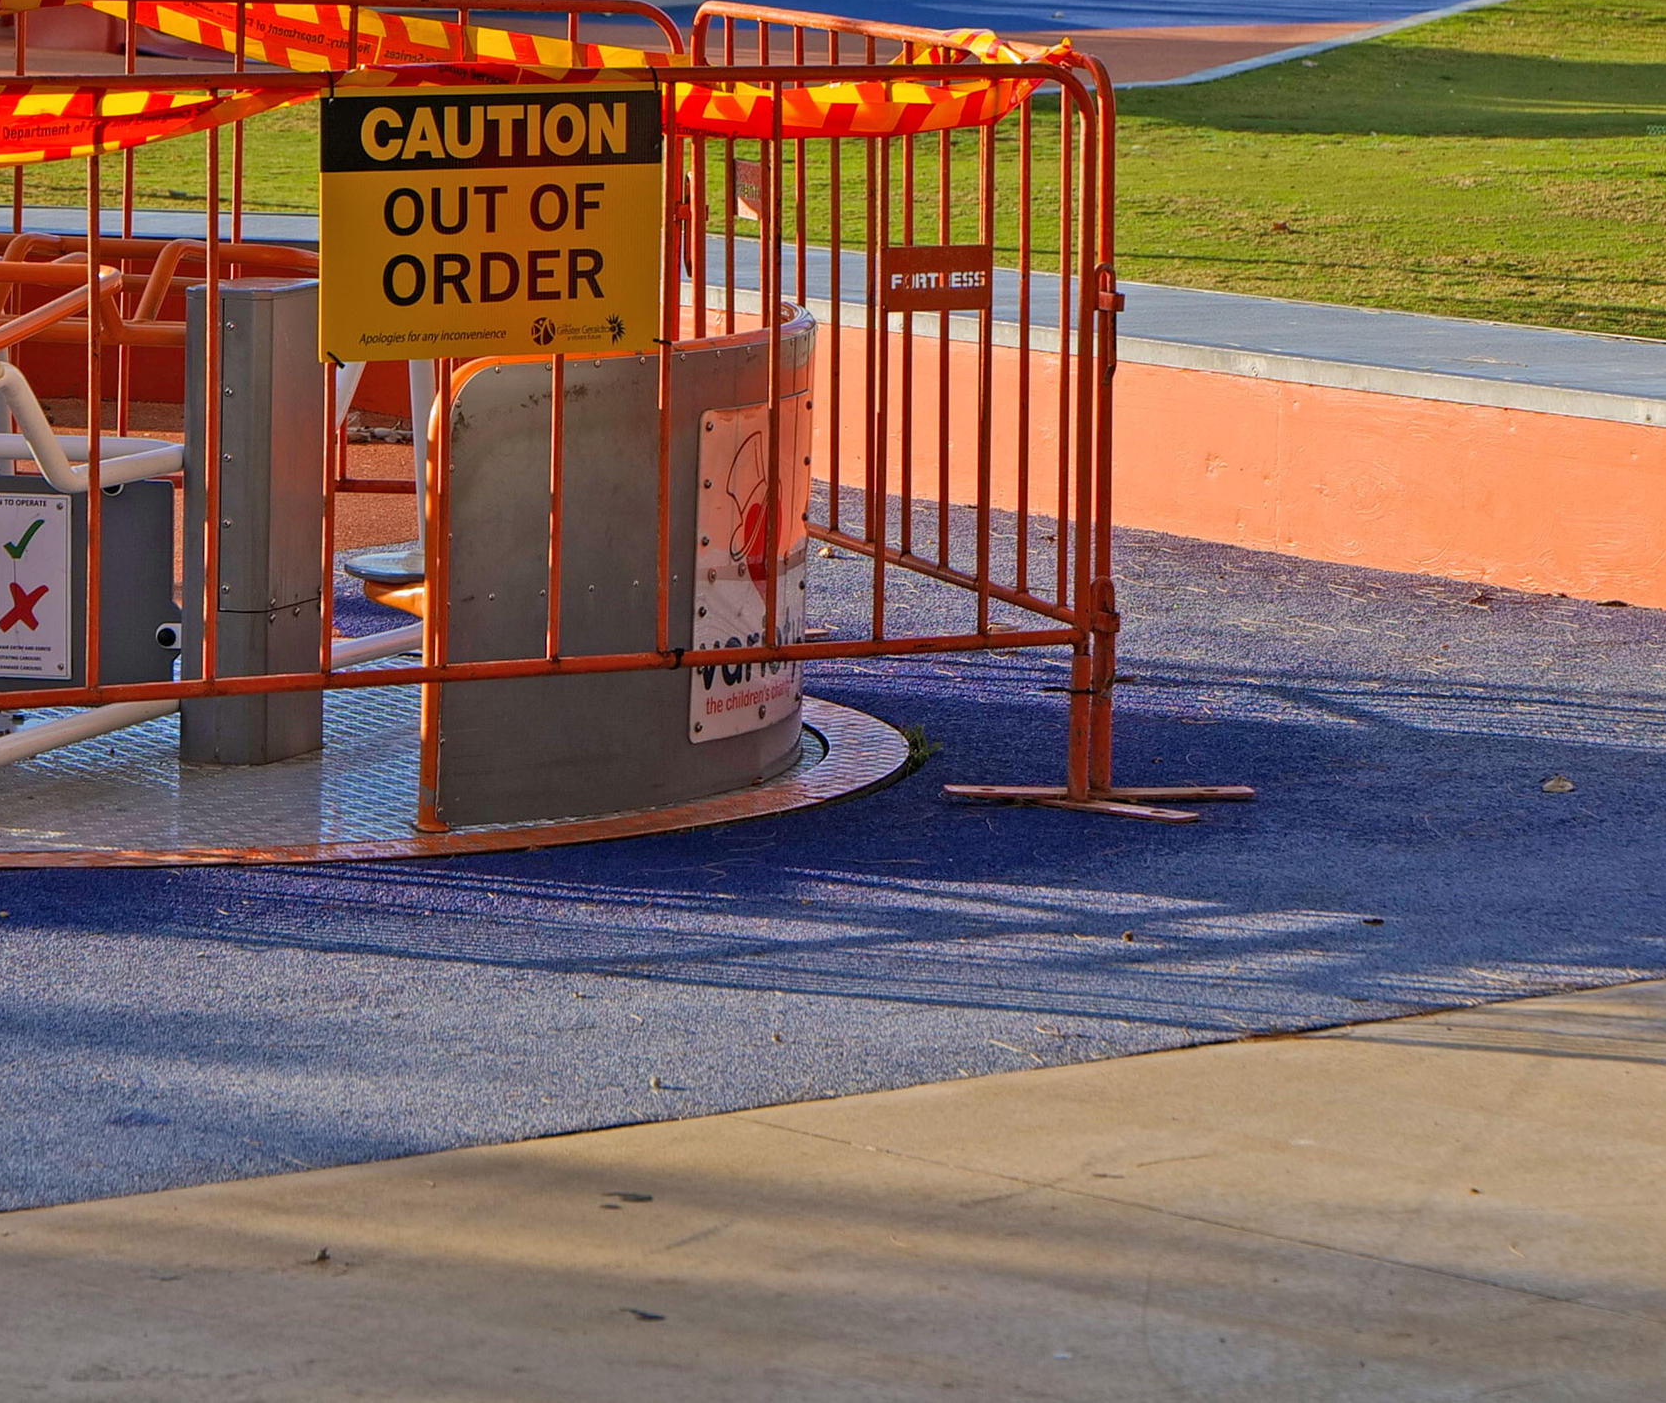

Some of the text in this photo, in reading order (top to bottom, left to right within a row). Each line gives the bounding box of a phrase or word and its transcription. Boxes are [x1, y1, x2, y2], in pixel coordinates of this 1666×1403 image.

[2, 123, 70, 142] Department
[360, 101, 628, 162] CAUTION
[383, 182, 605, 237] OUT OF
[382, 249, 605, 307] ORDER
[359, 328, 507, 347] Apologies for any inconvenience
[15, 499, 47, 507] OPERATE
[706, 697, 724, 715] the
[725, 686, 770, 711] children's
